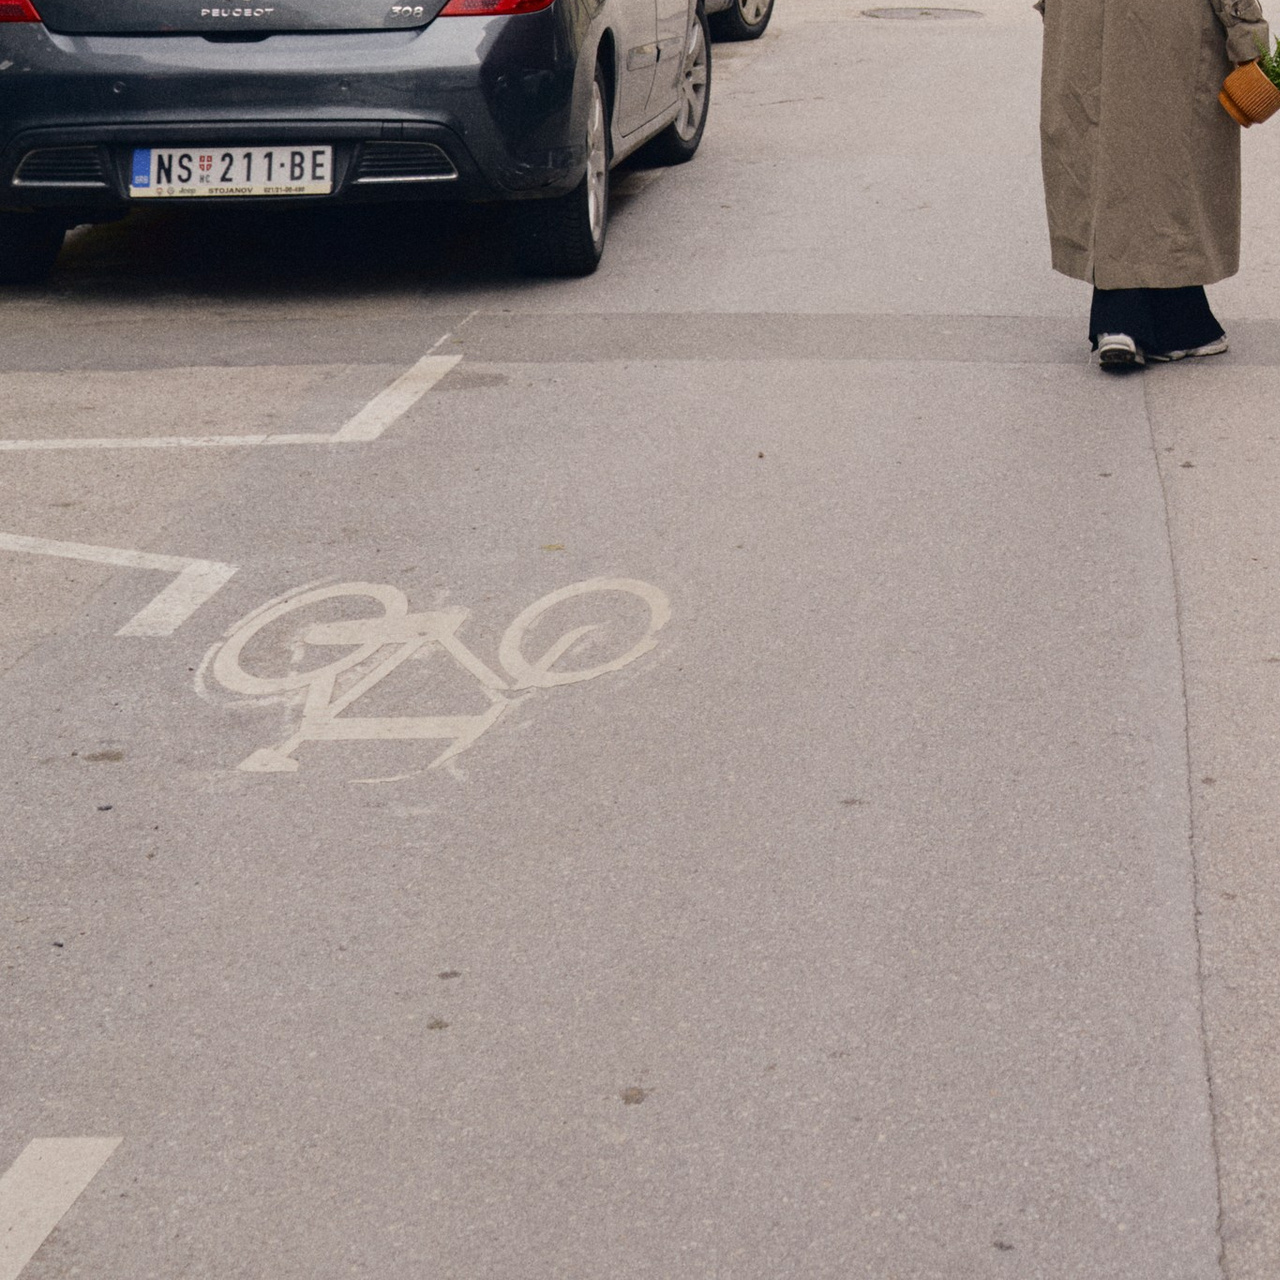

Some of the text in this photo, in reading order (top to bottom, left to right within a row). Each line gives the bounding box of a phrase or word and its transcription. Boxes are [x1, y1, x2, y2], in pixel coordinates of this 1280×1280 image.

[201, 8, 274, 17] PEUGEOT
[391, 6, 424, 17] 308
[156, 153, 193, 185] NS
